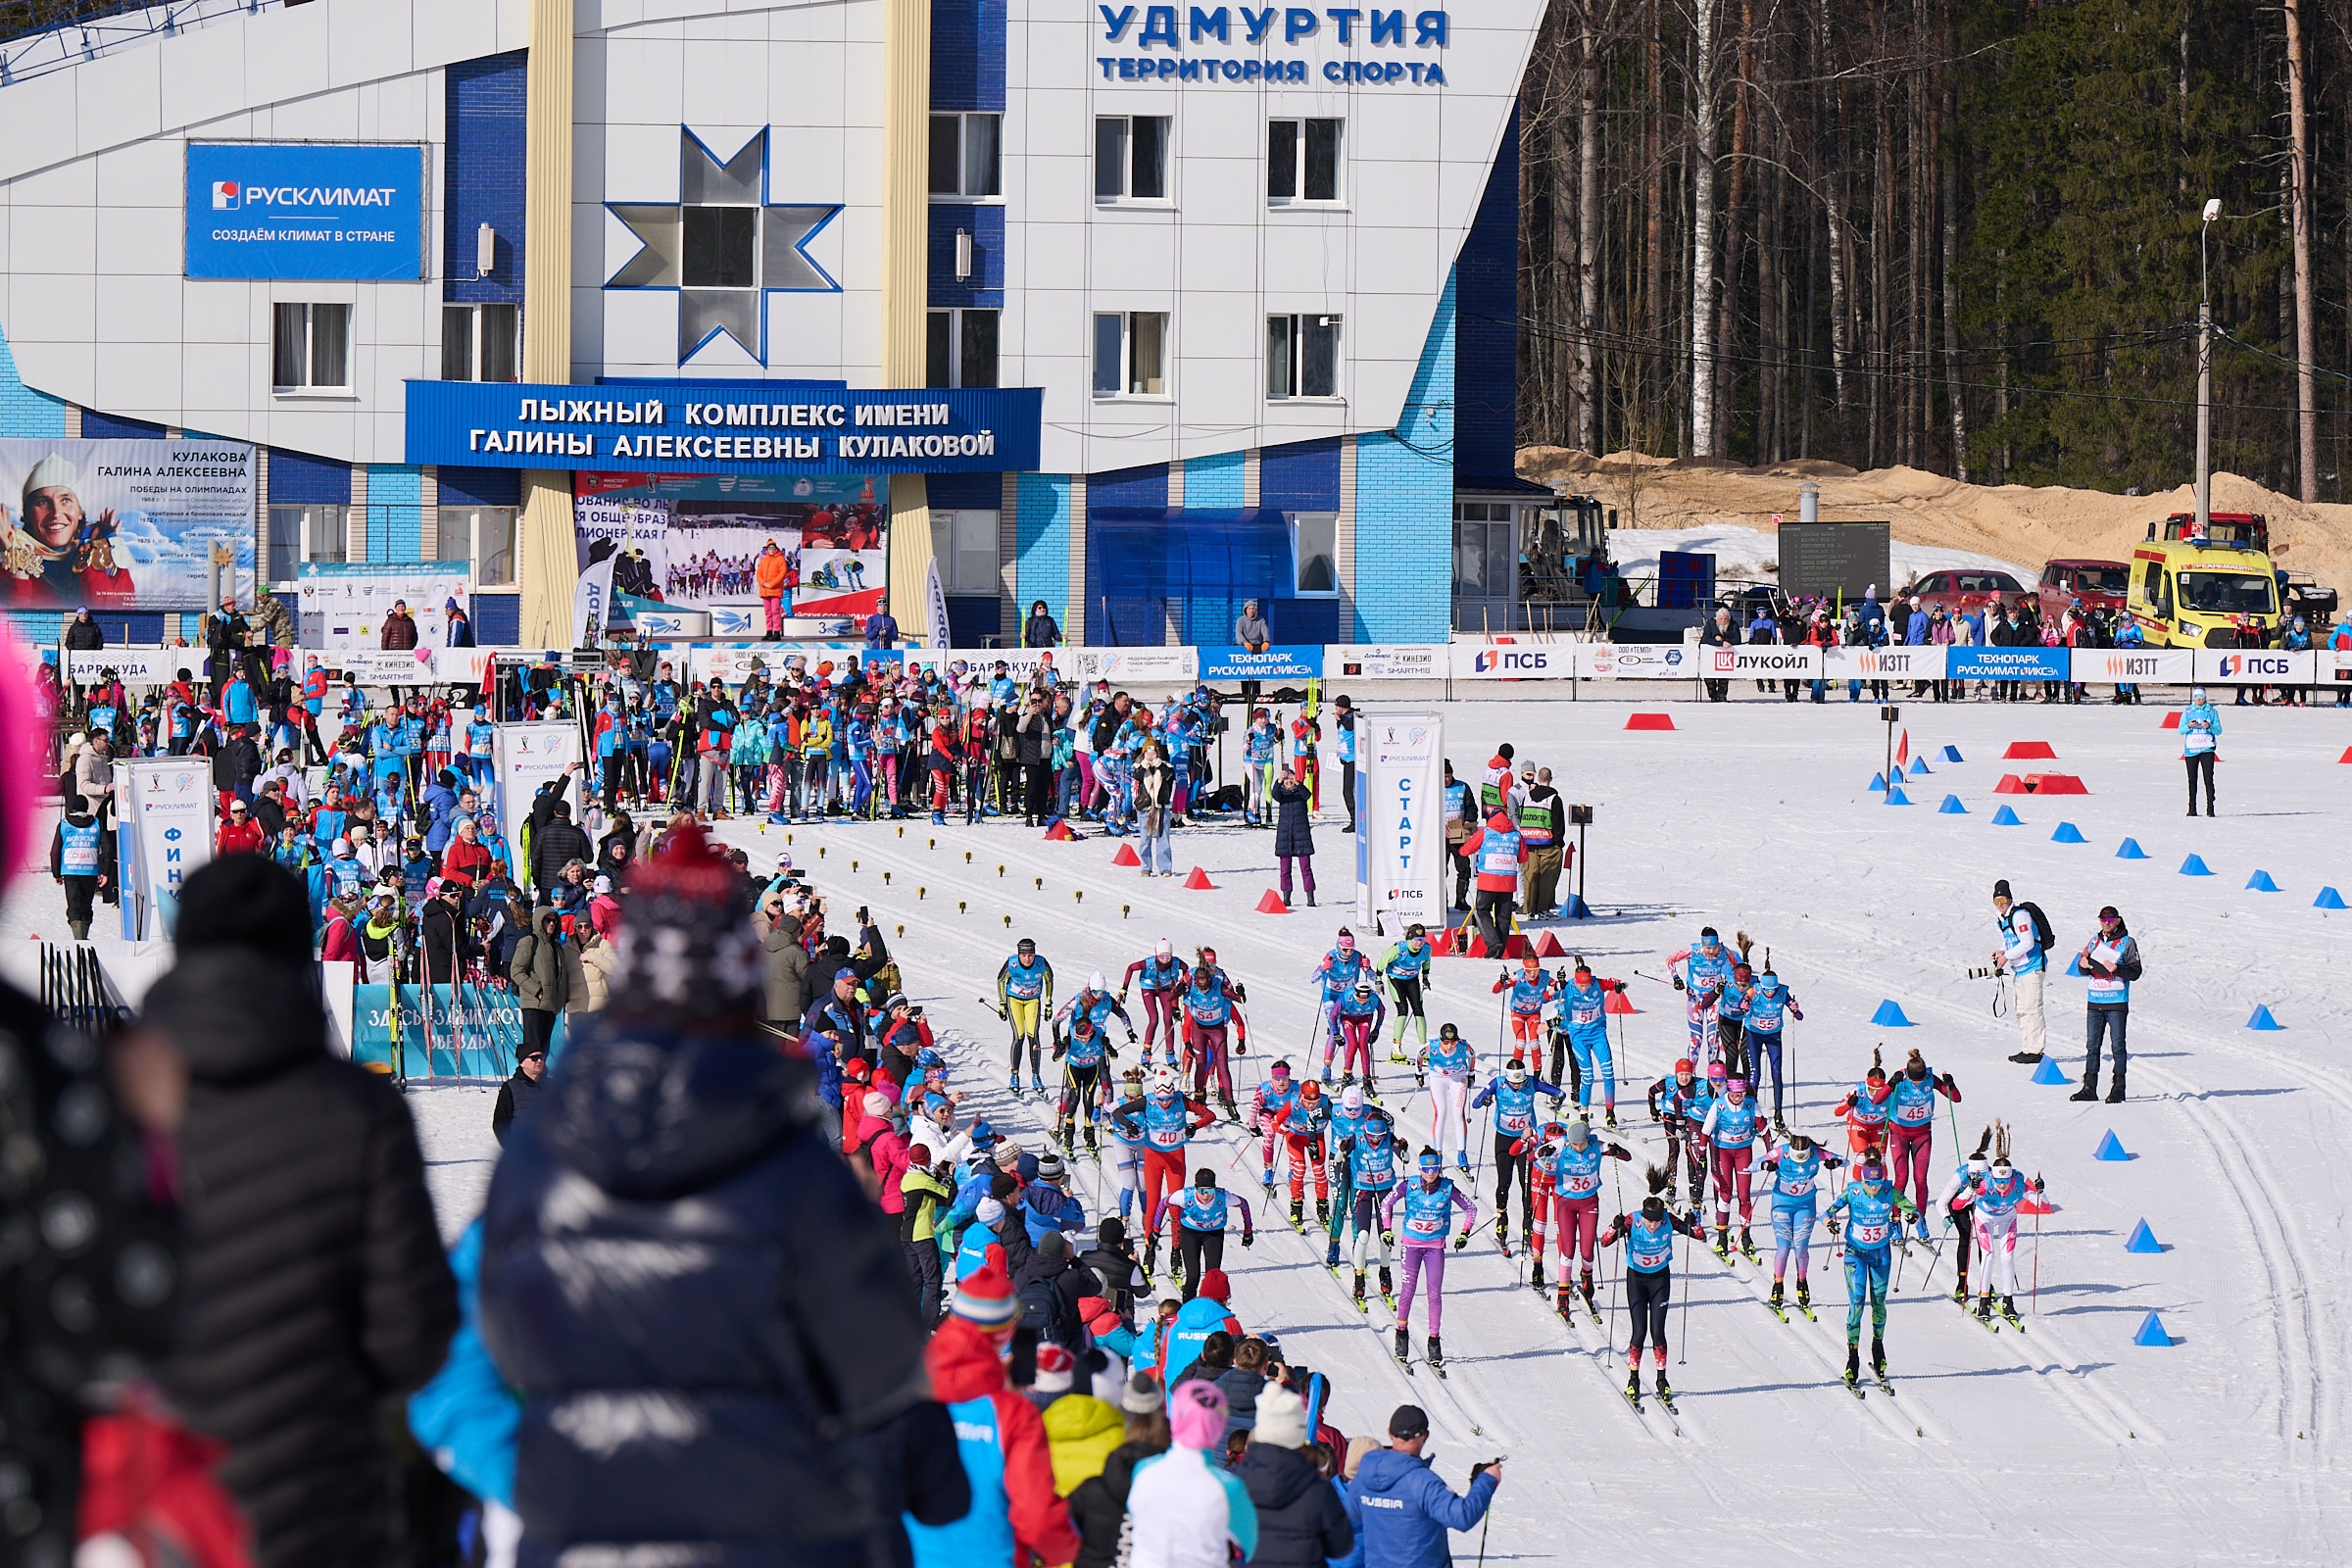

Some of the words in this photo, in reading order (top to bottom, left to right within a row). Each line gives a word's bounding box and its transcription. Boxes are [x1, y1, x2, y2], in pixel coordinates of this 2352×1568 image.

[1100, 5, 1446, 47] УДМУРТИЯ
[1097, 57, 1305, 81] ТЕРРИТОРИЯ
[1323, 61, 1445, 84] СПОРТА
[246, 187, 396, 206] РУСКЛИМАТ
[212, 227, 275, 243] СОЗДАЁМ
[278, 229, 331, 242] КЛИМАТ
[335, 230, 343, 242] В
[346, 230, 395, 243] СТРАНЕ
[518, 398, 663, 423] ЛЫЖНЫЙ
[685, 403, 846, 425] КОМПЛЕКС
[855, 403, 950, 425] ИМЕНИ
[469, 429, 593, 457] ГАЛИНЫ
[612, 435, 819, 459] АЛЕКСЕЕВНЫ
[839, 429, 996, 458] КУЛАКОВОЙ
[172, 452, 247, 463] КУЛАКОВА
[98, 466, 152, 477] ГАЛИНА
[157, 466, 247, 478] АЛЕКСЕЕВНА
[672, 619, 681, 631] 2
[818, 621, 827, 634] 3
[384, 661, 416, 669] КИНЕЗИО
[1228, 654, 1293, 663] ТЕХНОПАРК
[1503, 654, 1548, 669] ПСБ
[1736, 653, 1809, 669] ЛУКОЙЛ
[1880, 656, 1911, 672] ИЗТТ
[1977, 654, 2040, 663] ТЕХНОПАРК
[71, 664, 148, 676] БАРРКУДА
[1208, 665, 1273, 676] РУСКЛИМАТ
[1957, 665, 2020, 676] РУСКЛИМАТ
[2126, 658, 2158, 674] ИЗТТ
[2247, 658, 2289, 674] ПСБ
[661, 704, 673, 713] 39
[1398, 778, 1412, 869] СТАРТ
[1401, 890, 1424, 899] ПСБ
[368, 1009, 421, 1027] ЗДСЬ
[1198, 1010, 1213, 1020] 54
[1580, 1010, 1593, 1023] 57
[1758, 1019, 1775, 1030] 55
[1906, 1107, 1925, 1120] 45
[1507, 1117, 1526, 1130] 46
[1158, 1132, 1177, 1144] 40
[1572, 1177, 1591, 1192] 36
[1862, 1227, 1882, 1242] 33
[1177, 1332, 1211, 1341] RUSS
[1360, 1494, 1404, 1510] RUSSIA
